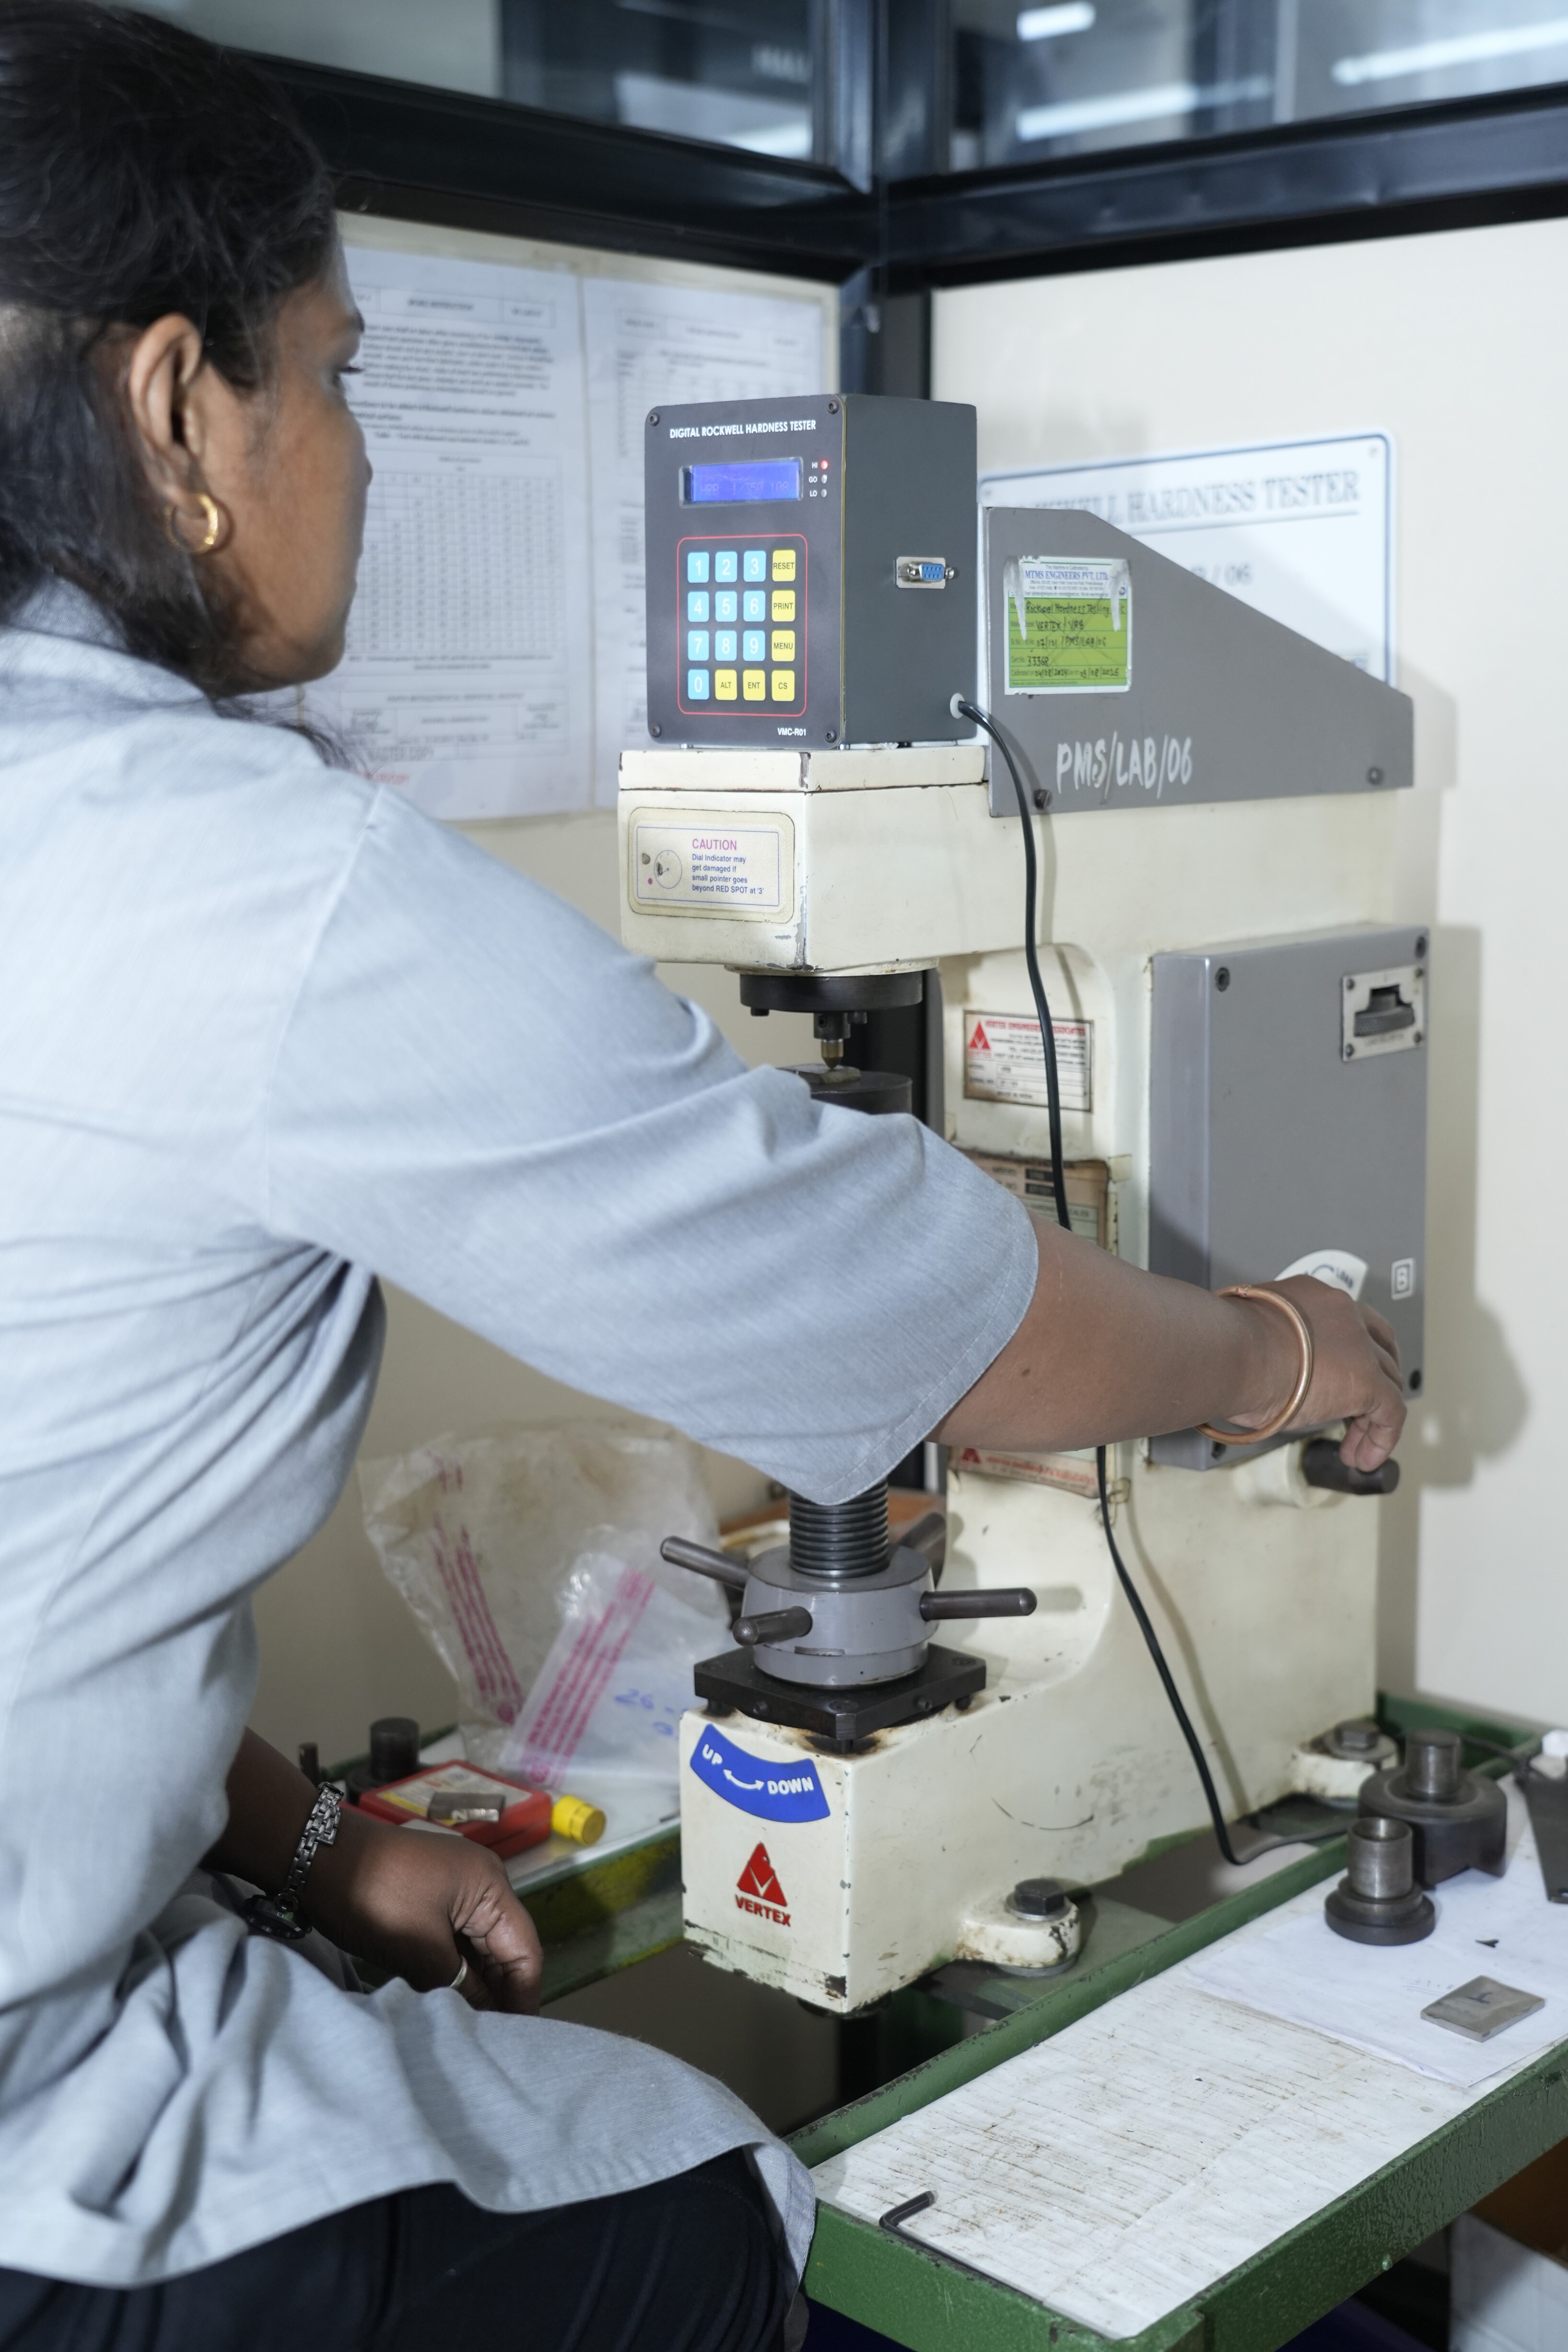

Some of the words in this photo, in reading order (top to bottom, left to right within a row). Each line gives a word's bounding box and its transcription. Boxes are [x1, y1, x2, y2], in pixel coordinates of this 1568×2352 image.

[670, 427, 700, 438] DIGITAL
[702, 424, 744, 436] ROCKWELL
[746, 422, 788, 434] HARDNESS
[790, 420, 816, 431] TESTER
[1126, 480, 1257, 524] HARDNESS
[1265, 470, 1361, 509] TESTER
[695, 559, 702, 576] 1
[722, 559, 731, 575] 2
[750, 558, 759, 574] 3
[1025, 570, 1044, 579] MTMS
[1045, 571, 1080, 580] ENGINEERS
[694, 599, 702, 615] 4
[722, 598, 730, 615] 5
[750, 598, 759, 615] 6
[694, 637, 702, 654] 7
[722, 637, 730, 654] 8
[749, 637, 759, 654] 9
[694, 676, 702, 693] 0
[777, 727, 807, 736] VMC-R01
[1056, 731, 1192, 800] PMS/LAB/06
[692, 839, 737, 850] CAUTION
[705, 854, 732, 863] Indicator
[734, 856, 746, 864] may
[703, 865, 731, 873] damaged
[692, 884, 714, 893] beyond
[710, 876, 732, 884] pointer
[702, 1744, 723, 1766] UP
[768, 1777, 815, 1795] DOWN
[735, 1894, 791, 1927] VERTEX
